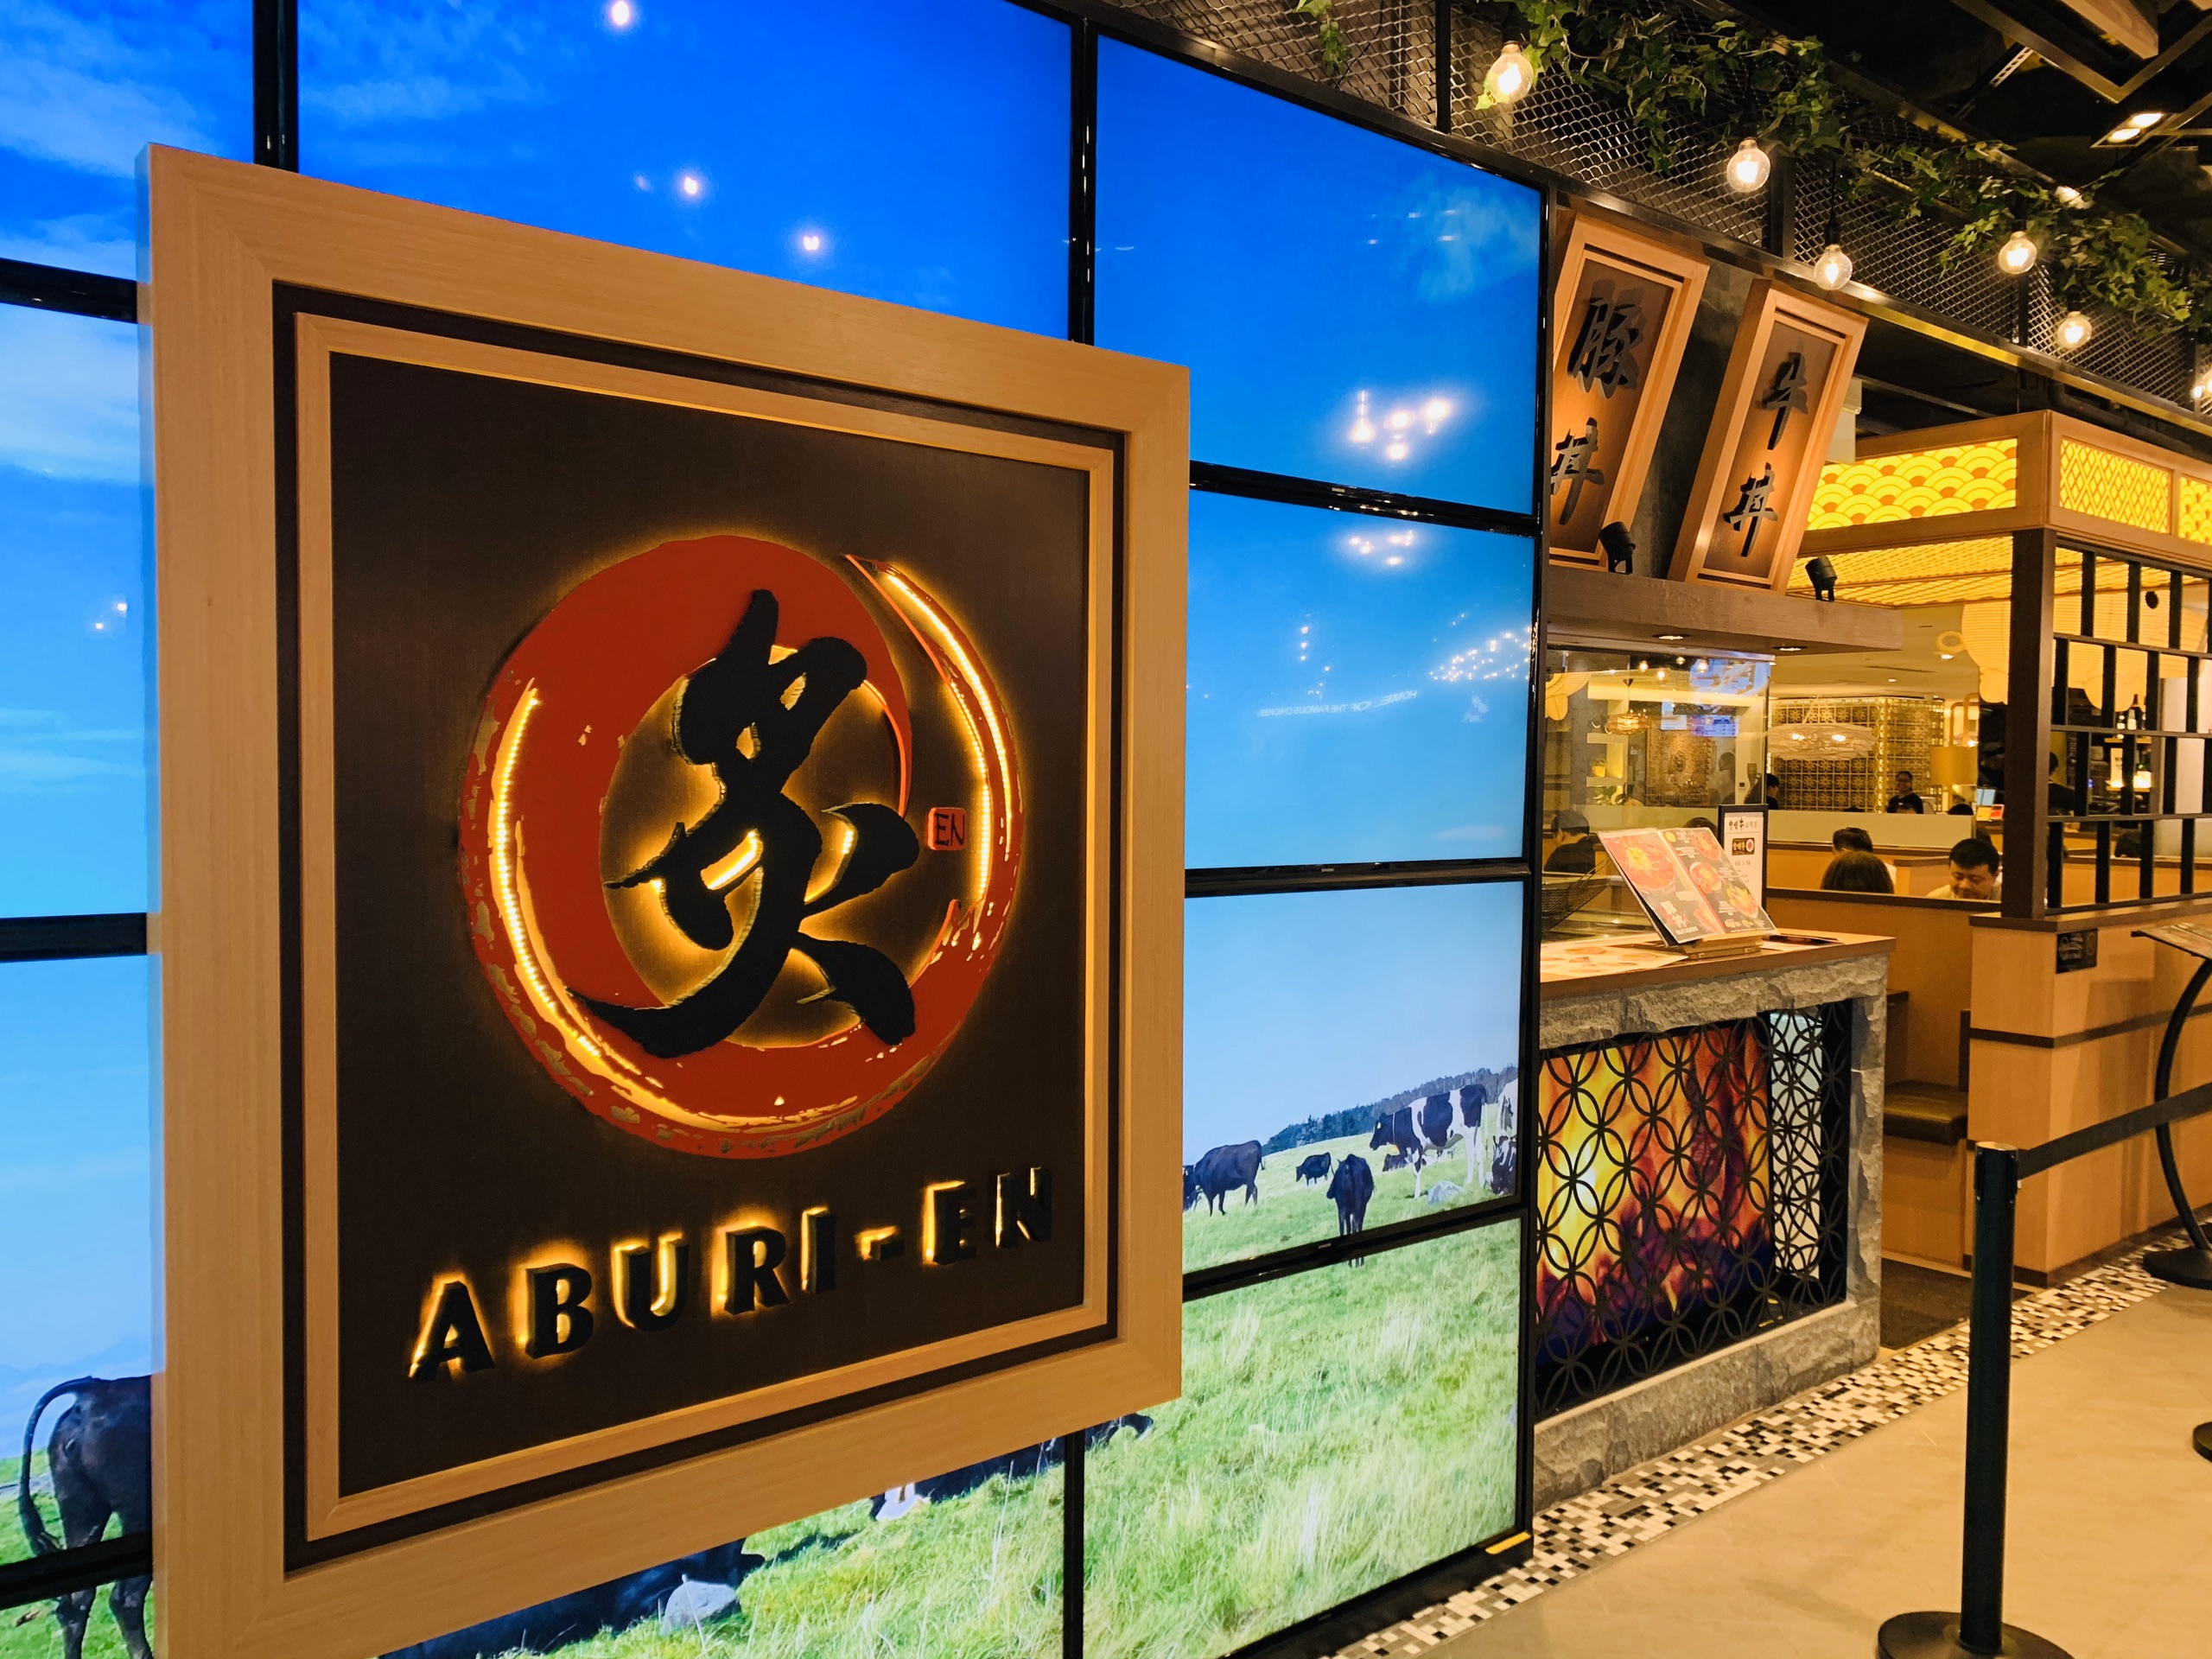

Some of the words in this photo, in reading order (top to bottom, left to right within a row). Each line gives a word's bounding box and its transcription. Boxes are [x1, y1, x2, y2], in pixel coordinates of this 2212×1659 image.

[1551, 289, 1642, 525] 豚丼
[1723, 352, 1808, 557] 牛丼
[566, 589, 919, 1058] 炙
[934, 813, 965, 847] EN
[407, 1165, 1052, 1382] ABURI-EN
